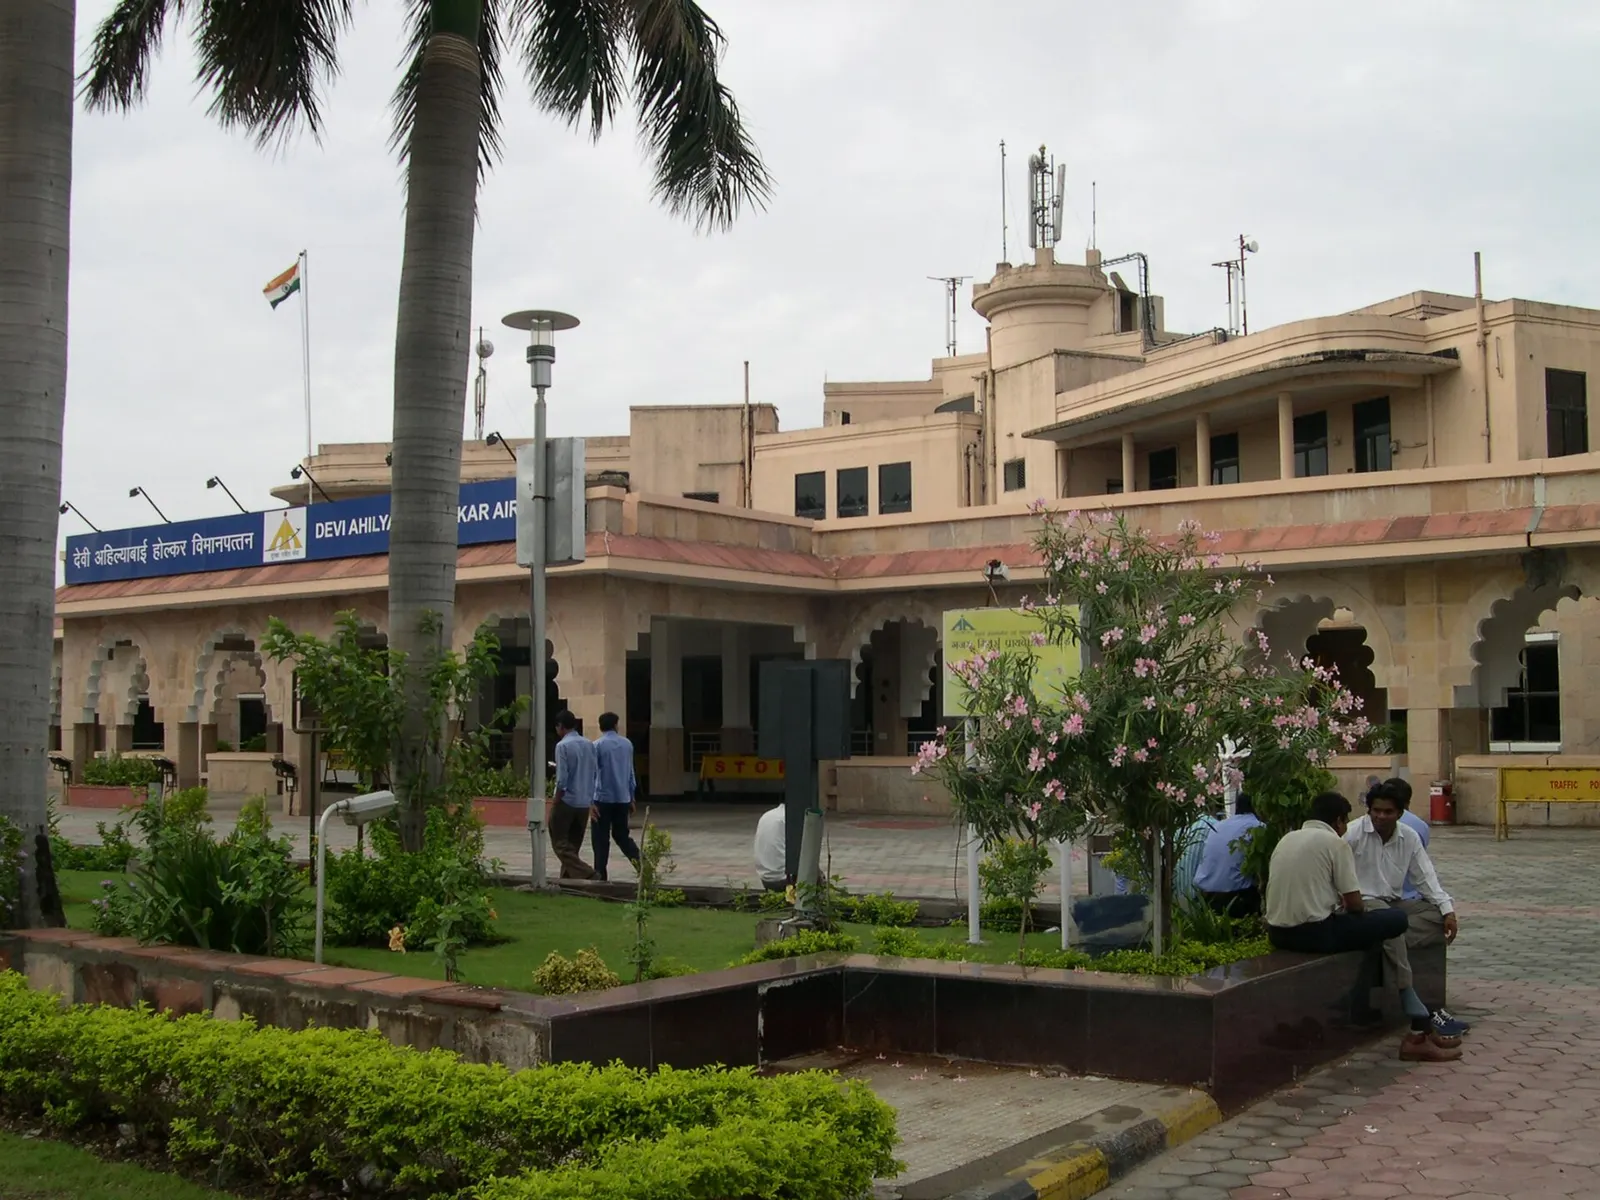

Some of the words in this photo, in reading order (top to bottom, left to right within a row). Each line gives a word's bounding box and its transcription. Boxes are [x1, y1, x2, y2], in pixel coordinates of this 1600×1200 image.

[315, 519, 346, 539] DEVI
[457, 503, 490, 523] KAR
[492, 499, 518, 519] AIR
[73, 546, 91, 569] देवी
[94, 538, 148, 566] अहिल्याबाई
[152, 536, 187, 560] होल्कर
[191, 532, 254, 556] विमानपत्तन
[1550, 780, 1578, 789] TRAFFIC
[1589, 780, 1600, 789] PO
